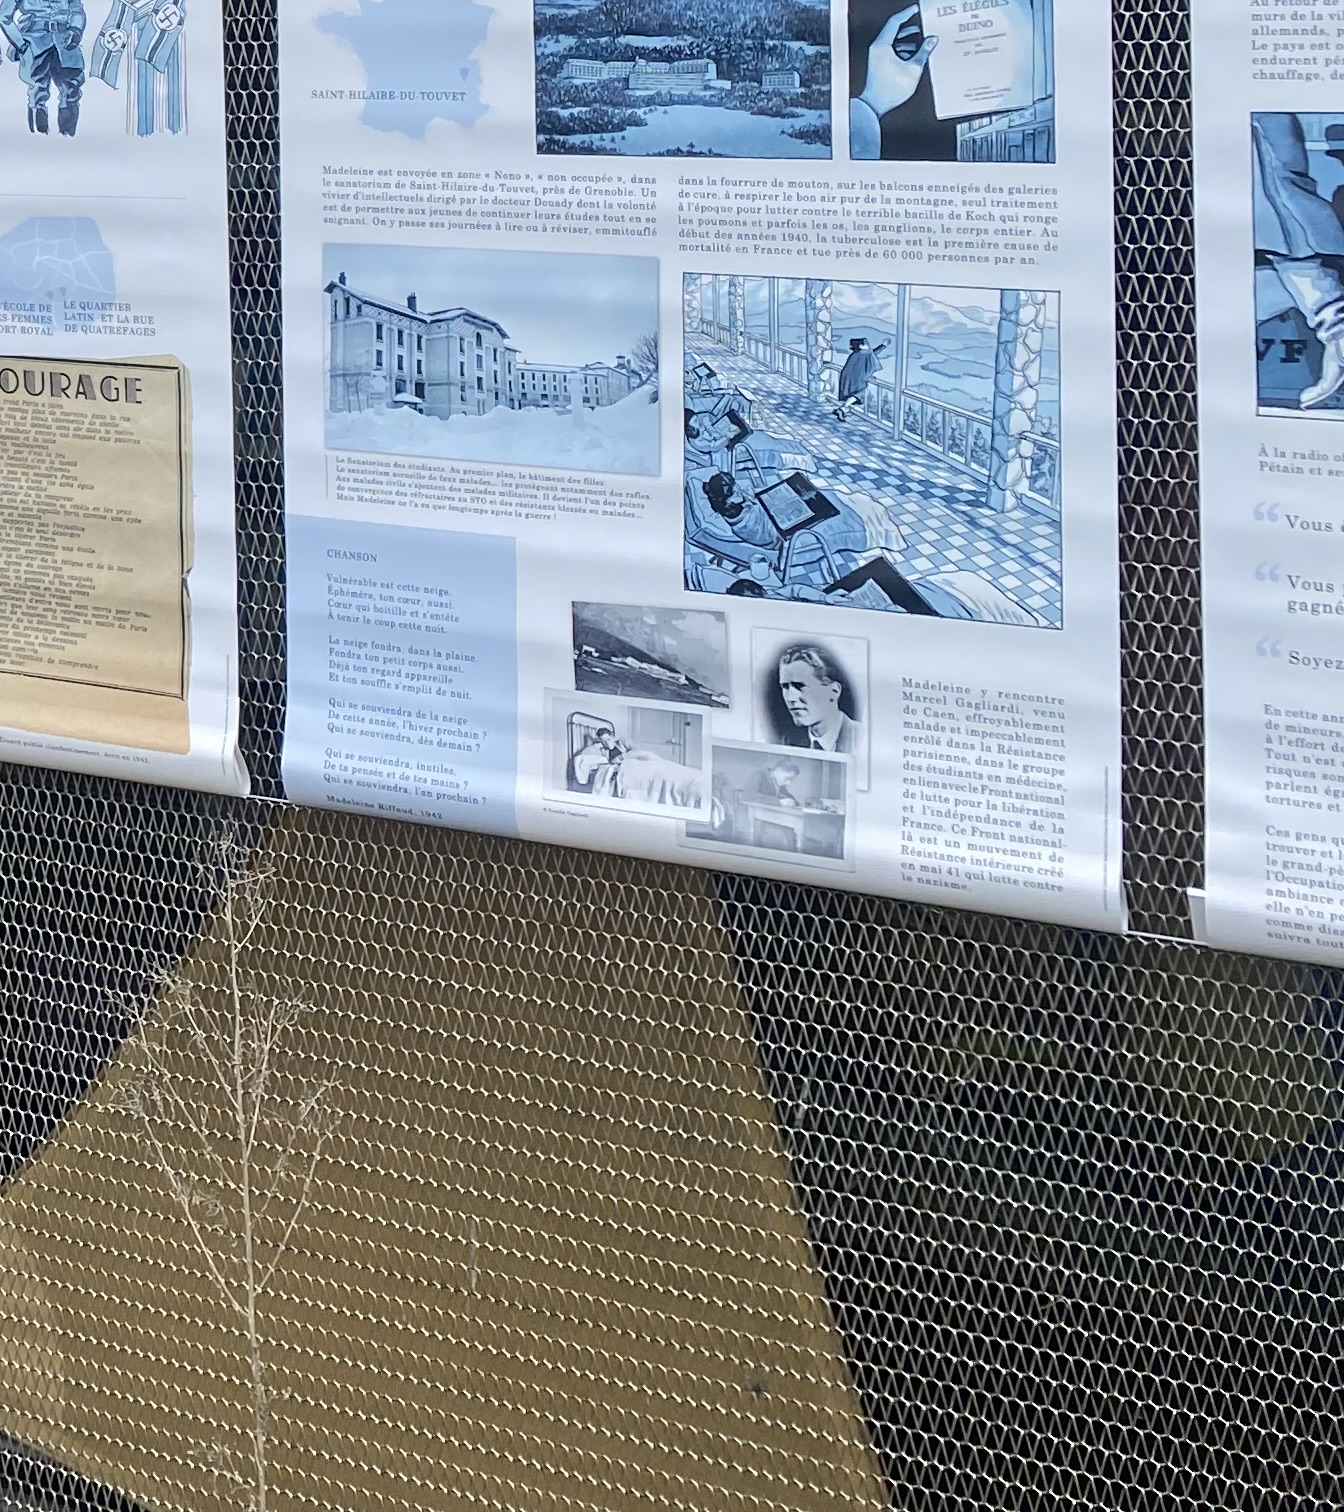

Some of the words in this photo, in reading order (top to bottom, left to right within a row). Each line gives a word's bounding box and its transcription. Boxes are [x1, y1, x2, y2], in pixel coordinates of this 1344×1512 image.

[937, 6, 957, 17] LES
[1291, 11, 1306, 21] de
[1311, 10, 1323, 21] la
[1251, 25, 1330, 36] allemands,
[1251, 40, 1268, 50] Le
[1273, 42, 1305, 52] pays
[1310, 42, 1329, 50] est
[1252, 55, 1317, 65] endurent
[1252, 69, 1325, 82] chauffage,
[311, 90, 466, 101] SAINT-HILAIRE-DU-TOUVET
[677, 175, 703, 186] dans
[706, 176, 717, 186] la
[720, 176, 767, 187] fourrure
[770, 177, 784, 188] de
[787, 178, 833, 192] mouton,
[859, 180, 876, 190] les
[878, 180, 923, 191] balcons
[926, 181, 980, 196] enneigés
[983, 183, 1004, 193] des
[1007, 184, 1057, 198] galeries
[678, 241, 731, 253] mortalité
[752, 243, 792, 255] France
[796, 245, 808, 256] et
[811, 246, 831, 257] tue
[835, 247, 860, 260] près
[864, 248, 878, 258] de
[882, 249, 897, 259] 60
[900, 249, 923, 260] 000
[927, 254, 989, 266] personnes
[994, 256, 1015, 267] par
[39, 304, 52, 312] DE
[64, 301, 76, 309] LE
[80, 302, 131, 311] QUARTIER
[64, 312, 94, 321] LATIN
[101, 314, 113, 322] ET
[117, 314, 129, 323] LA
[133, 315, 154, 324] RUE
[65, 324, 77, 332] DE
[81, 325, 156, 336] QUATREFAGES
[1258, 444, 1268, 457] À
[1274, 447, 1286, 459] la
[1292, 449, 1328, 461] radio
[1259, 461, 1304, 474] Pétain
[1310, 466, 1321, 476] et
[1285, 515, 1333, 532] Vous
[327, 549, 377, 562] CHANSON
[326, 572, 377, 587] Vulnérable
[379, 578, 394, 589] est
[396, 580, 420, 592] cette
[1287, 575, 1334, 593] Vous
[901, 677, 971, 695] Madeleine
[980, 689, 987, 699] y
[997, 688, 1065, 705] rencontre
[901, 690, 947, 705] Marcel
[954, 696, 1024, 717] Gagliardi,
[1032, 709, 1065, 720] venu
